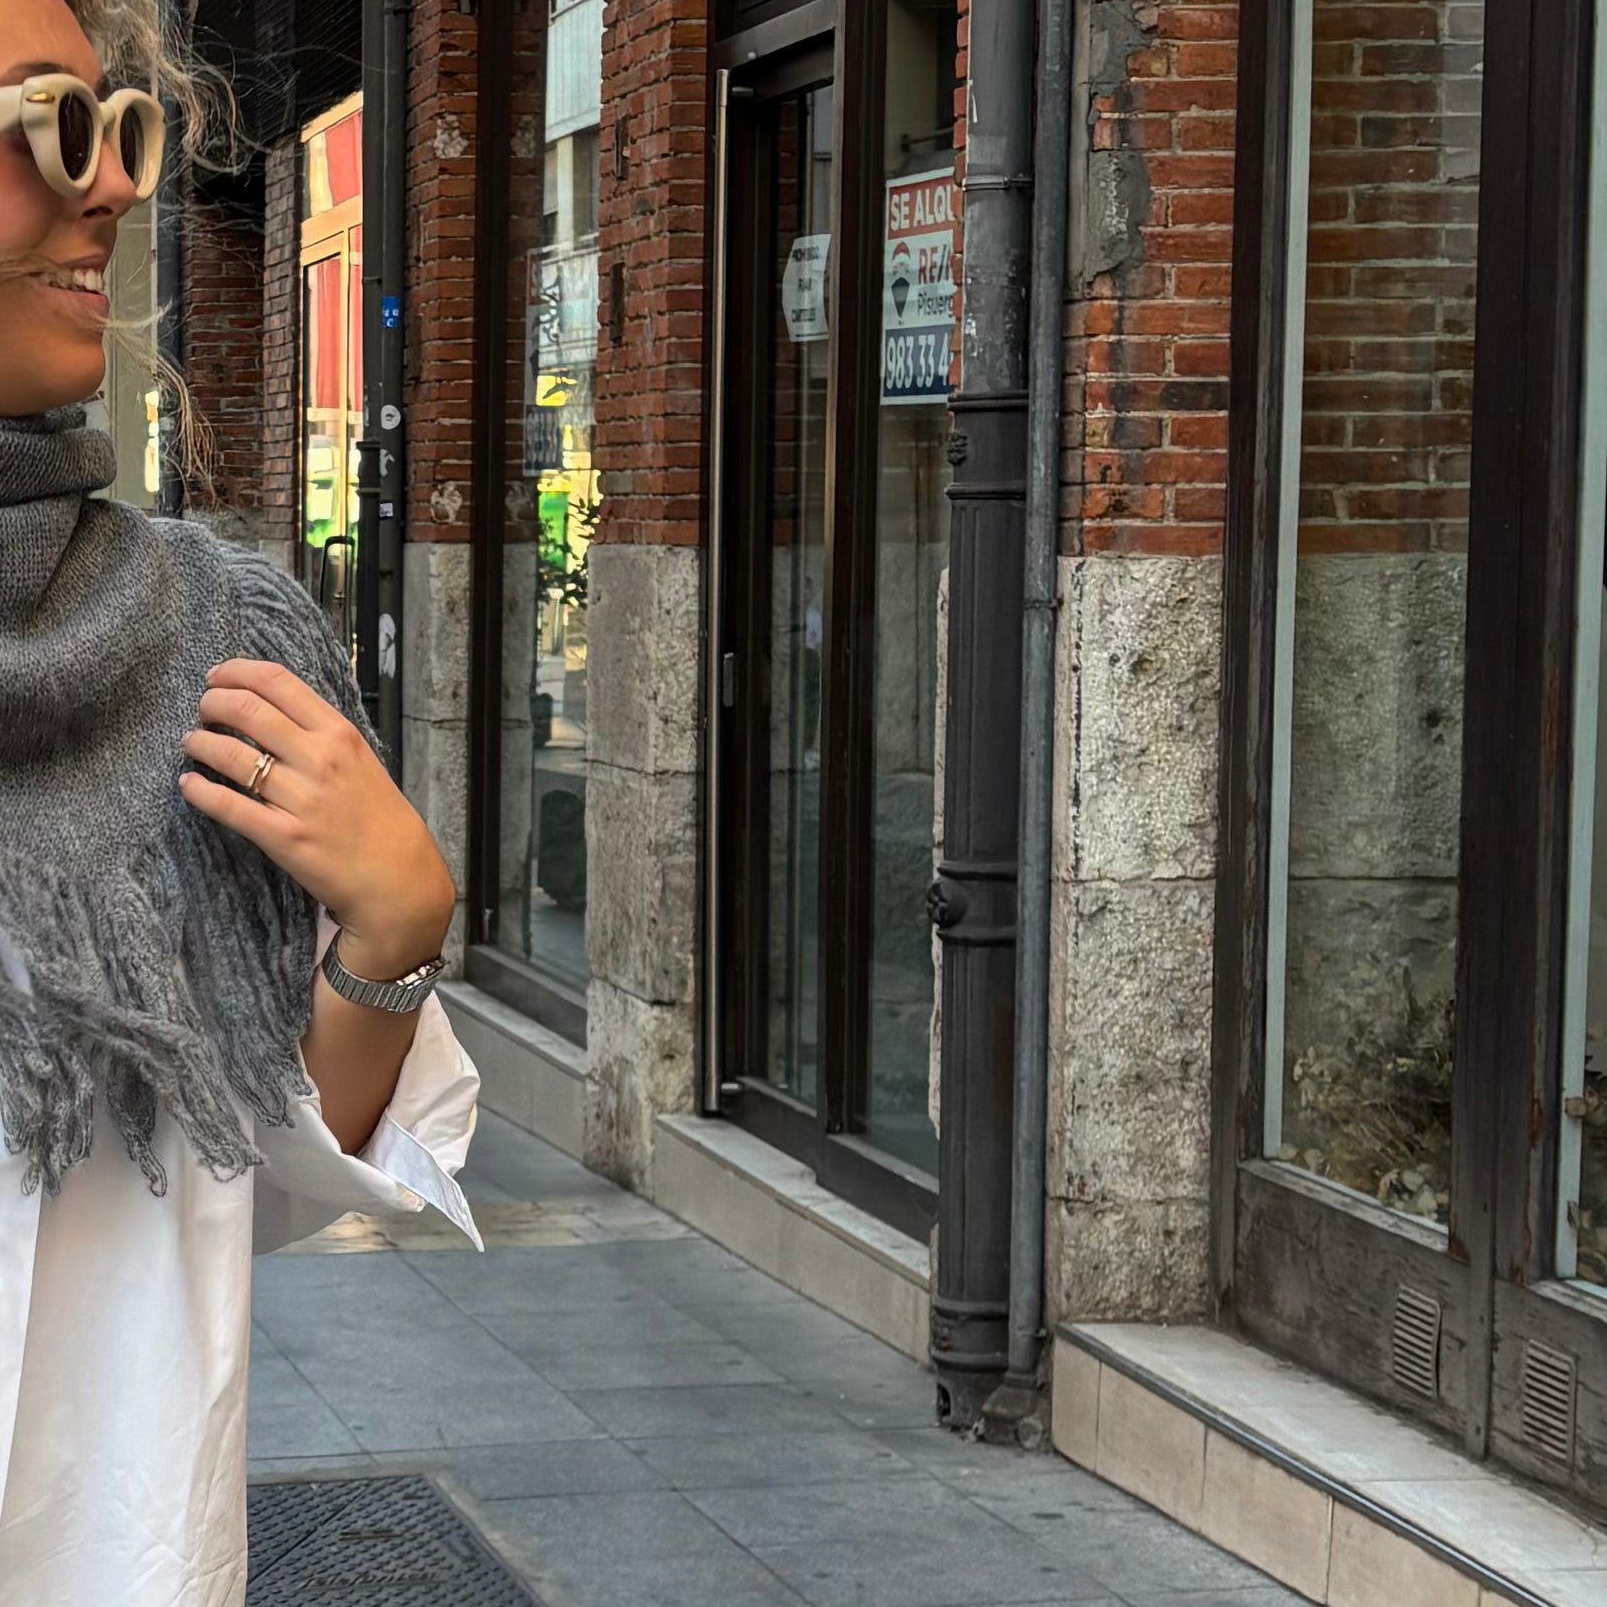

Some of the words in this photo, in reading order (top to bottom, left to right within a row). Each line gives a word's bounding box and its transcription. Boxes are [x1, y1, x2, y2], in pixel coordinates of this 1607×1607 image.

[890, 192, 910, 231] SE
[886, 335, 914, 390] 983
[916, 333, 936, 388] 33
[938, 332, 954, 387] 4
